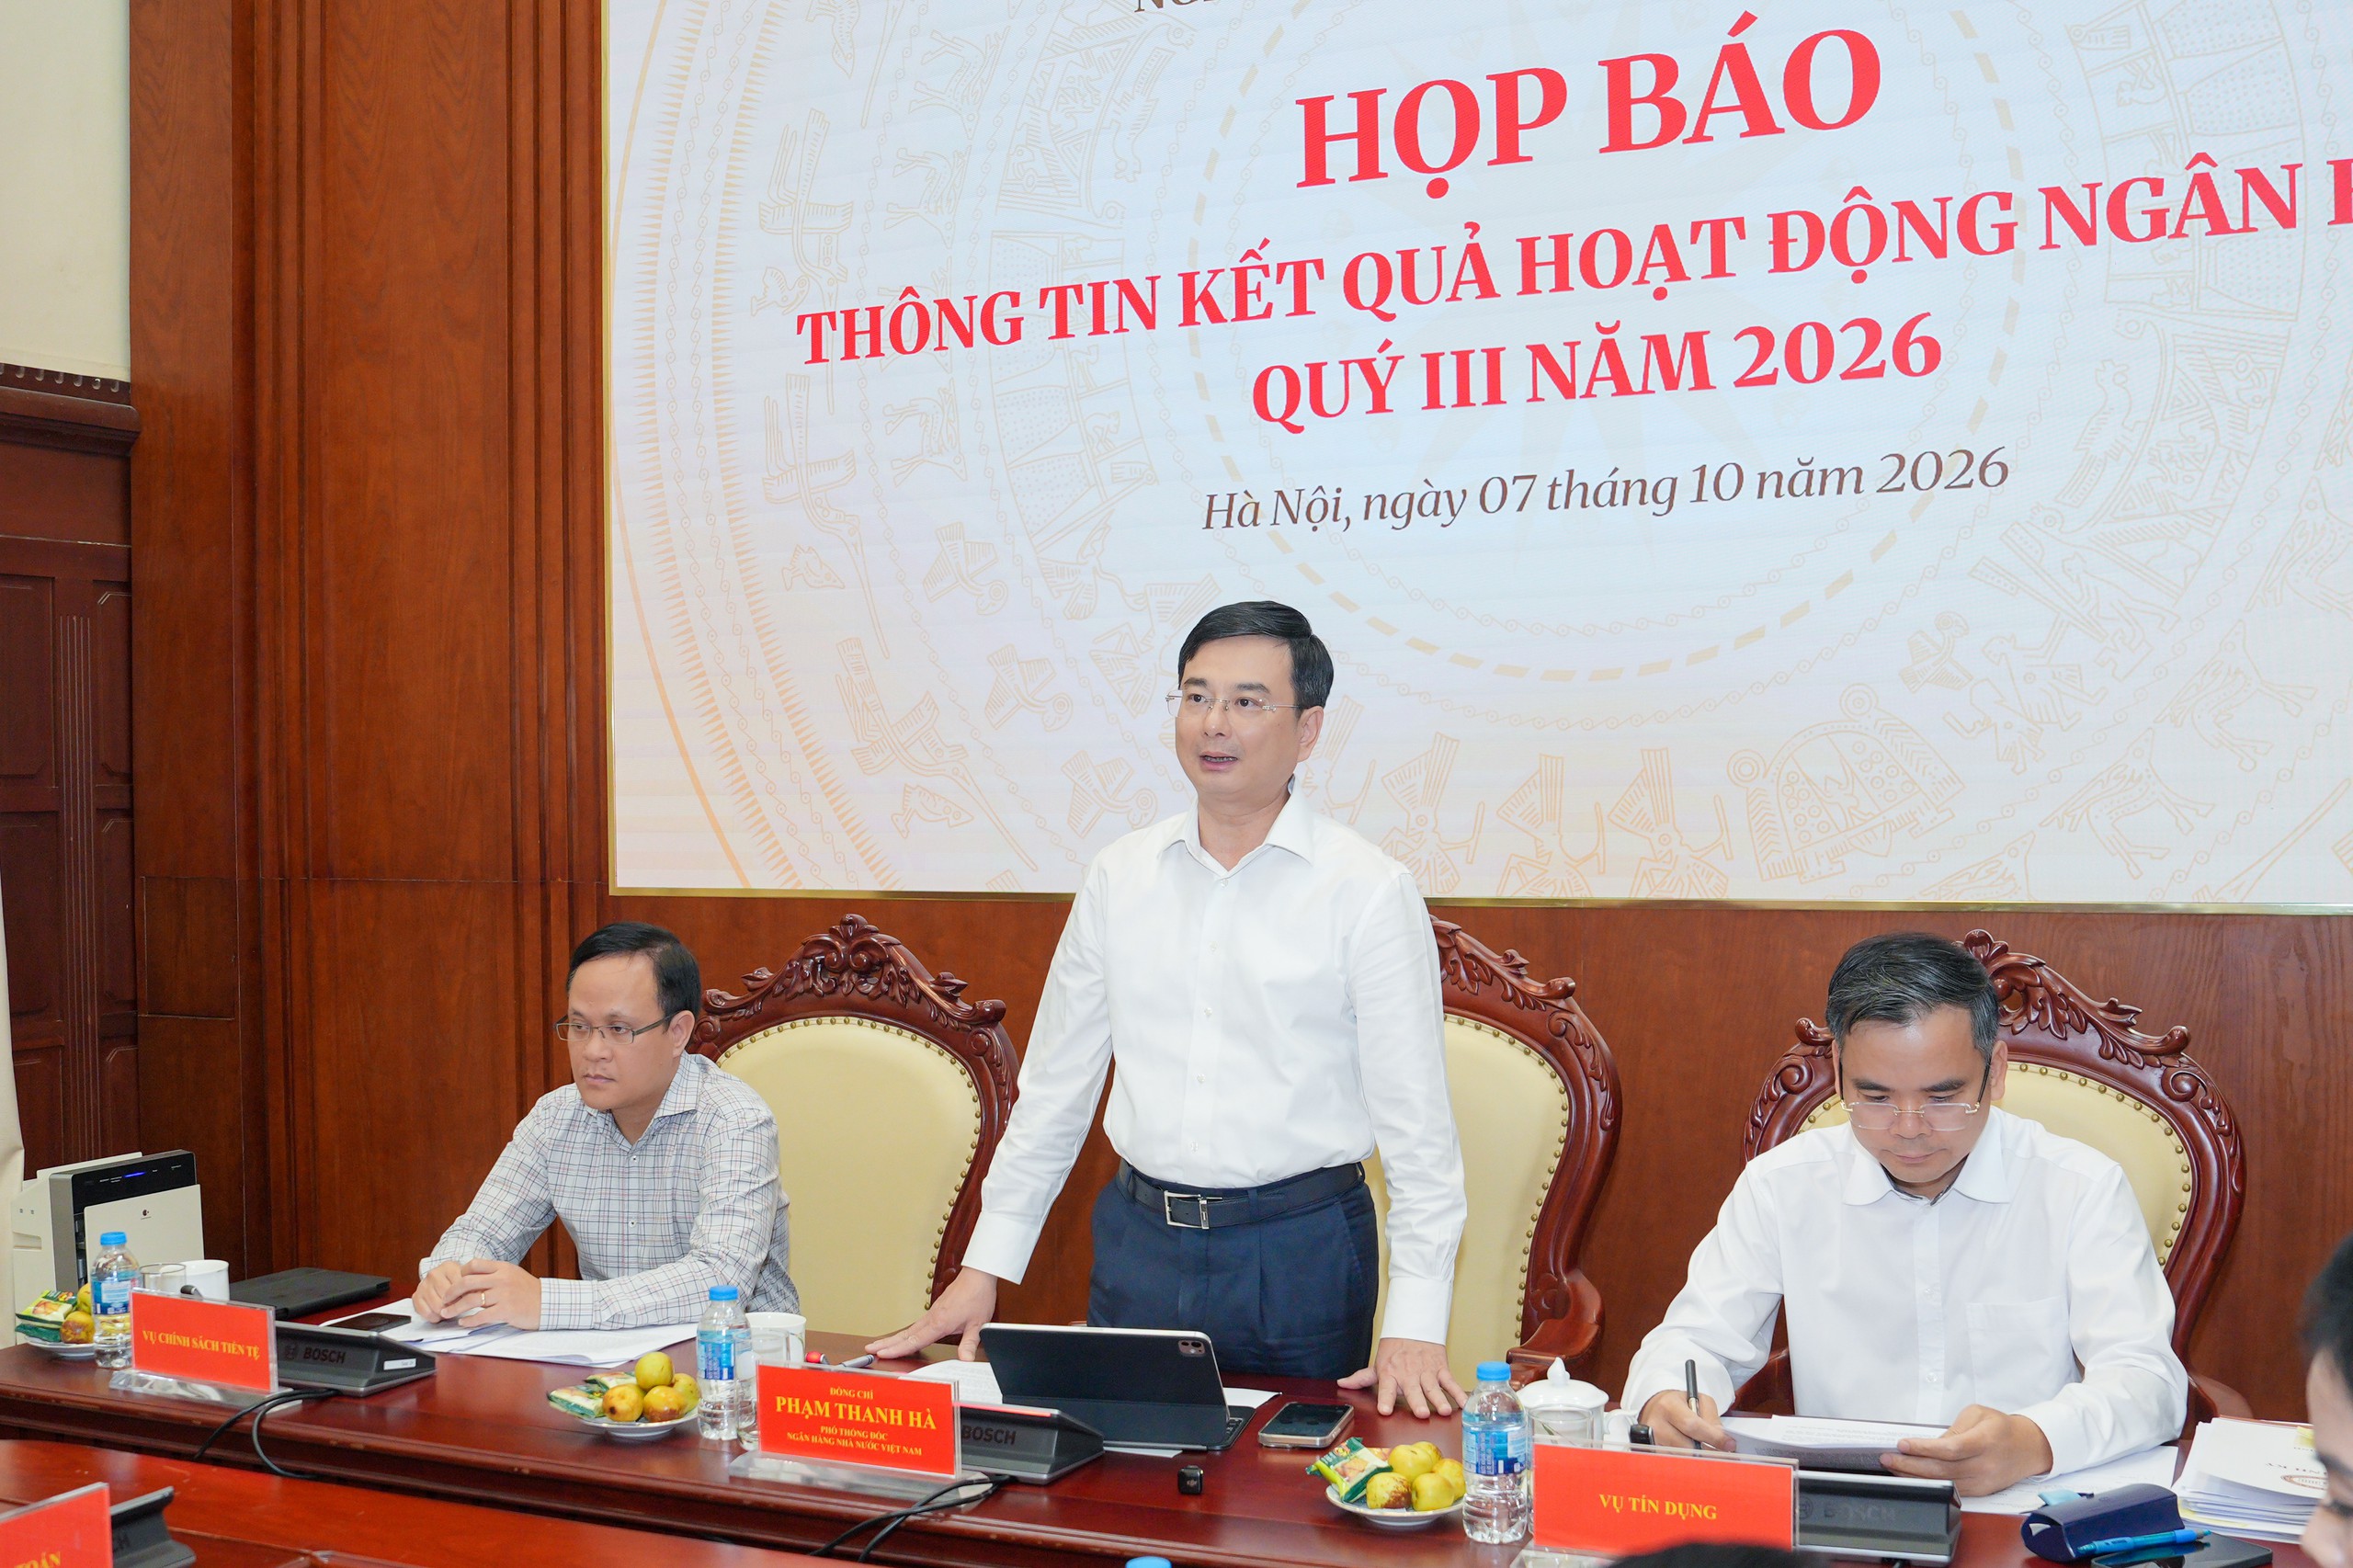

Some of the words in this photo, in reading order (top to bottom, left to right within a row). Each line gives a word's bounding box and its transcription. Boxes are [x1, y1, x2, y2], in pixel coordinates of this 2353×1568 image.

[1295, 67, 1568, 199] HỌP
[1597, 10, 1881, 154] BÁO
[795, 286, 1025, 365] THÔNG
[1039, 275, 1162, 340] TIN
[1177, 237, 1324, 327] KẾT
[1343, 222, 1501, 323] QUẢ
[1516, 216, 1746, 301] HOẠT
[1767, 186, 2018, 284] ĐỘNG
[2038, 152, 2303, 250] NGÂN
[1253, 338, 1405, 435] QUÝ
[1421, 347, 1506, 411] III
[1526, 320, 1717, 403] NĂM
[1733, 312, 1941, 388] 2026
[1201, 489, 1261, 530] Hà
[1269, 484, 1351, 532] Nội,
[1363, 478, 1467, 531] ngày
[1479, 474, 1538, 514] 07
[1547, 466, 1678, 517] tháng
[1689, 462, 1745, 504] 10
[1756, 456, 1865, 500] năm
[1875, 446, 2009, 494] 2026
[142, 1330, 156, 1345] VỤ
[158, 1331, 190, 1347] CHÍNH
[191, 1335, 220, 1352] SÁCH
[246, 1345, 260, 1360] TỆ
[303, 1346, 346, 1364] BOSCH
[857, 1388, 874, 1400] CHÍ
[776, 1395, 831, 1420] PHẠM
[835, 1403, 904, 1426] THANH
[908, 1408, 937, 1429] HÀ
[961, 1425, 1017, 1445] BOSCH
[902, 1446, 923, 1456] NAM
[1598, 1494, 1624, 1514] VỤ
[1628, 1494, 1659, 1514] TÍN
[1665, 1500, 1718, 1521] DỤNG
